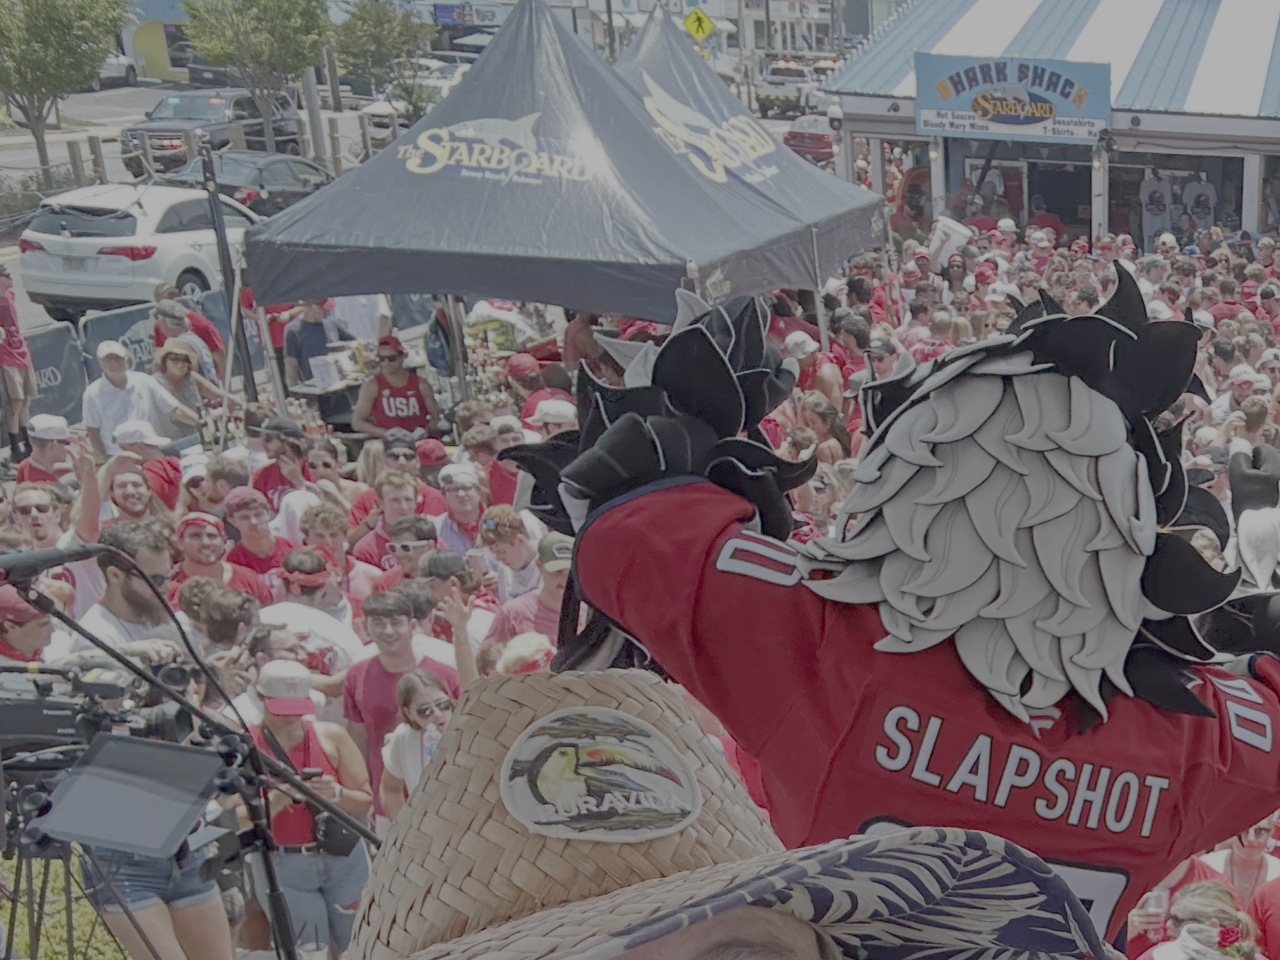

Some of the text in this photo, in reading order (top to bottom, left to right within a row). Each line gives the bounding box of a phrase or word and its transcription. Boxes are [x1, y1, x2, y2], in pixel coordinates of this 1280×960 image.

[974, 91, 1056, 120] STARBOARD
[936, 111, 976, 121] Hot Sauces
[1052, 117, 1095, 128] Sweatshirts
[923, 119, 946, 130] Bloody
[949, 121, 967, 132] Mary
[1042, 126, 1075, 137] T-Shirts
[396, 142, 425, 160] The
[405, 127, 595, 182] STARBOARD
[381, 396, 420, 418] USA
[875, 705, 1170, 838] SLAPSHOT
